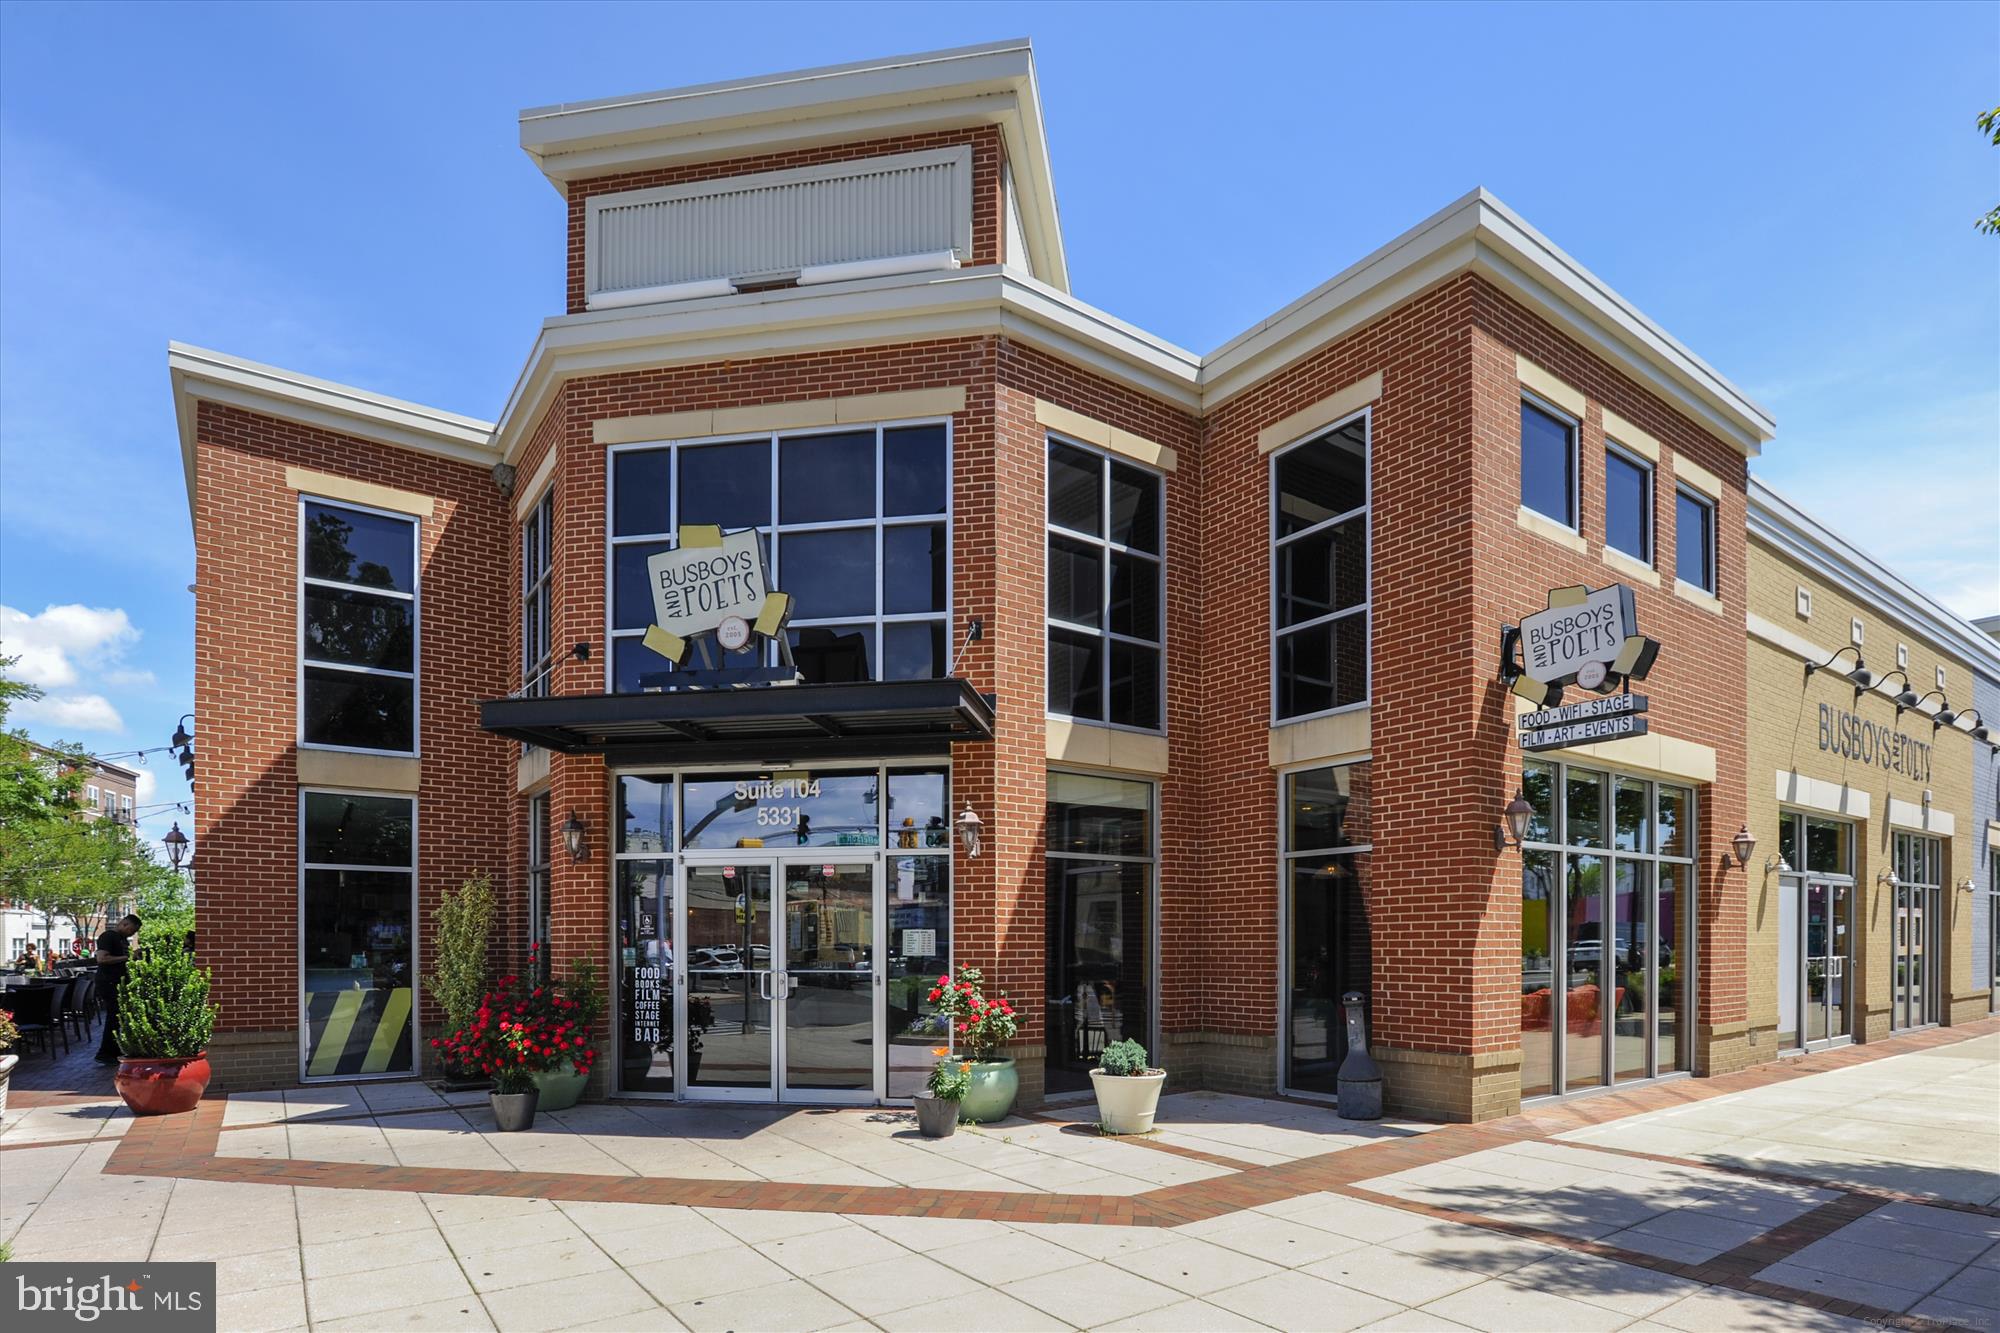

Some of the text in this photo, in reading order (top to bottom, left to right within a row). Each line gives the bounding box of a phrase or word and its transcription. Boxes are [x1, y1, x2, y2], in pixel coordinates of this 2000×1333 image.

[660, 550, 752, 589] BUSBOYS
[664, 572, 757, 618] AND POETS
[1531, 603, 1614, 645] BUSBOYS
[1533, 621, 1616, 668] AND POETS
[1522, 710, 1550, 727] FOOD
[1559, 705, 1582, 720] WIFI
[1592, 695, 1630, 715] STAGE
[1522, 731, 1545, 747] FILM
[1554, 726, 1576, 741] ART
[1585, 717, 1630, 737] EVENTS
[1819, 703, 1931, 783] BUSBOYS AND POETS
[734, 780, 821, 800] Suite 104
[757, 807, 801, 826] 5331
[635, 967, 660, 979] FOOD
[635, 980, 660, 989] BOOKS
[635, 989, 660, 1001] FILM
[635, 1001, 660, 1010] COFFEE
[635, 1010, 660, 1020] STAGE
[635, 1028, 660, 1042] BAR
